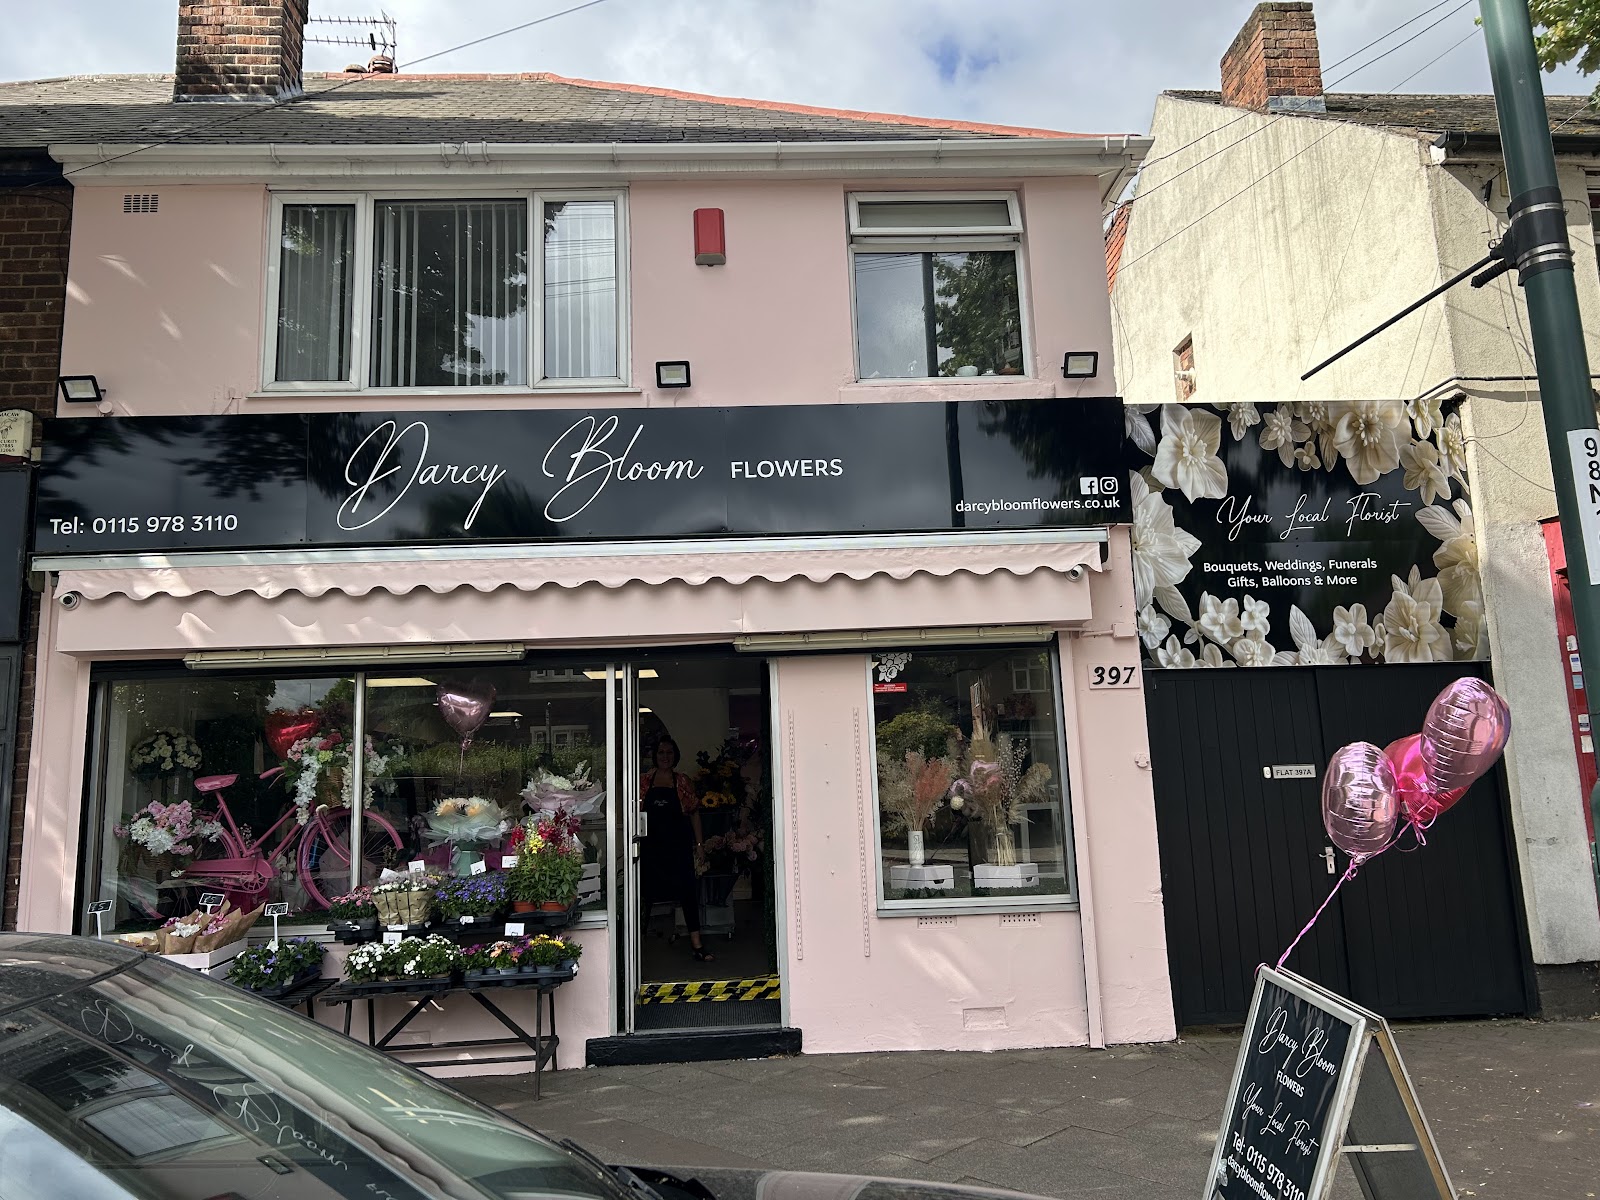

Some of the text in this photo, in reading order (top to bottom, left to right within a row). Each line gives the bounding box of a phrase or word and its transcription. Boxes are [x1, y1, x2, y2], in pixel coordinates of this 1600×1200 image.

[336, 415, 844, 530] Darcy Bloom FLOWERS
[955, 497, 1121, 514] darcybloomflowers.co.uk
[1216, 492, 1411, 541] Your Local Florist
[50, 514, 238, 534] Tel: 0115 978 3110
[1203, 558, 1378, 574] Bouquets, Weddings, Funerals
[1227, 575, 1358, 588] Gifts, Balloons & More
[1092, 666, 1136, 685] 397
[1258, 1006, 1336, 1078] Darcy Bloom
[1276, 1070, 1305, 1098] FLOWERS
[1242, 1082, 1320, 1156] Your Local Florist
[1232, 1131, 1246, 1155] Tel:
[1246, 1145, 1268, 1174] 0115
[1266, 1163, 1285, 1190] 978
